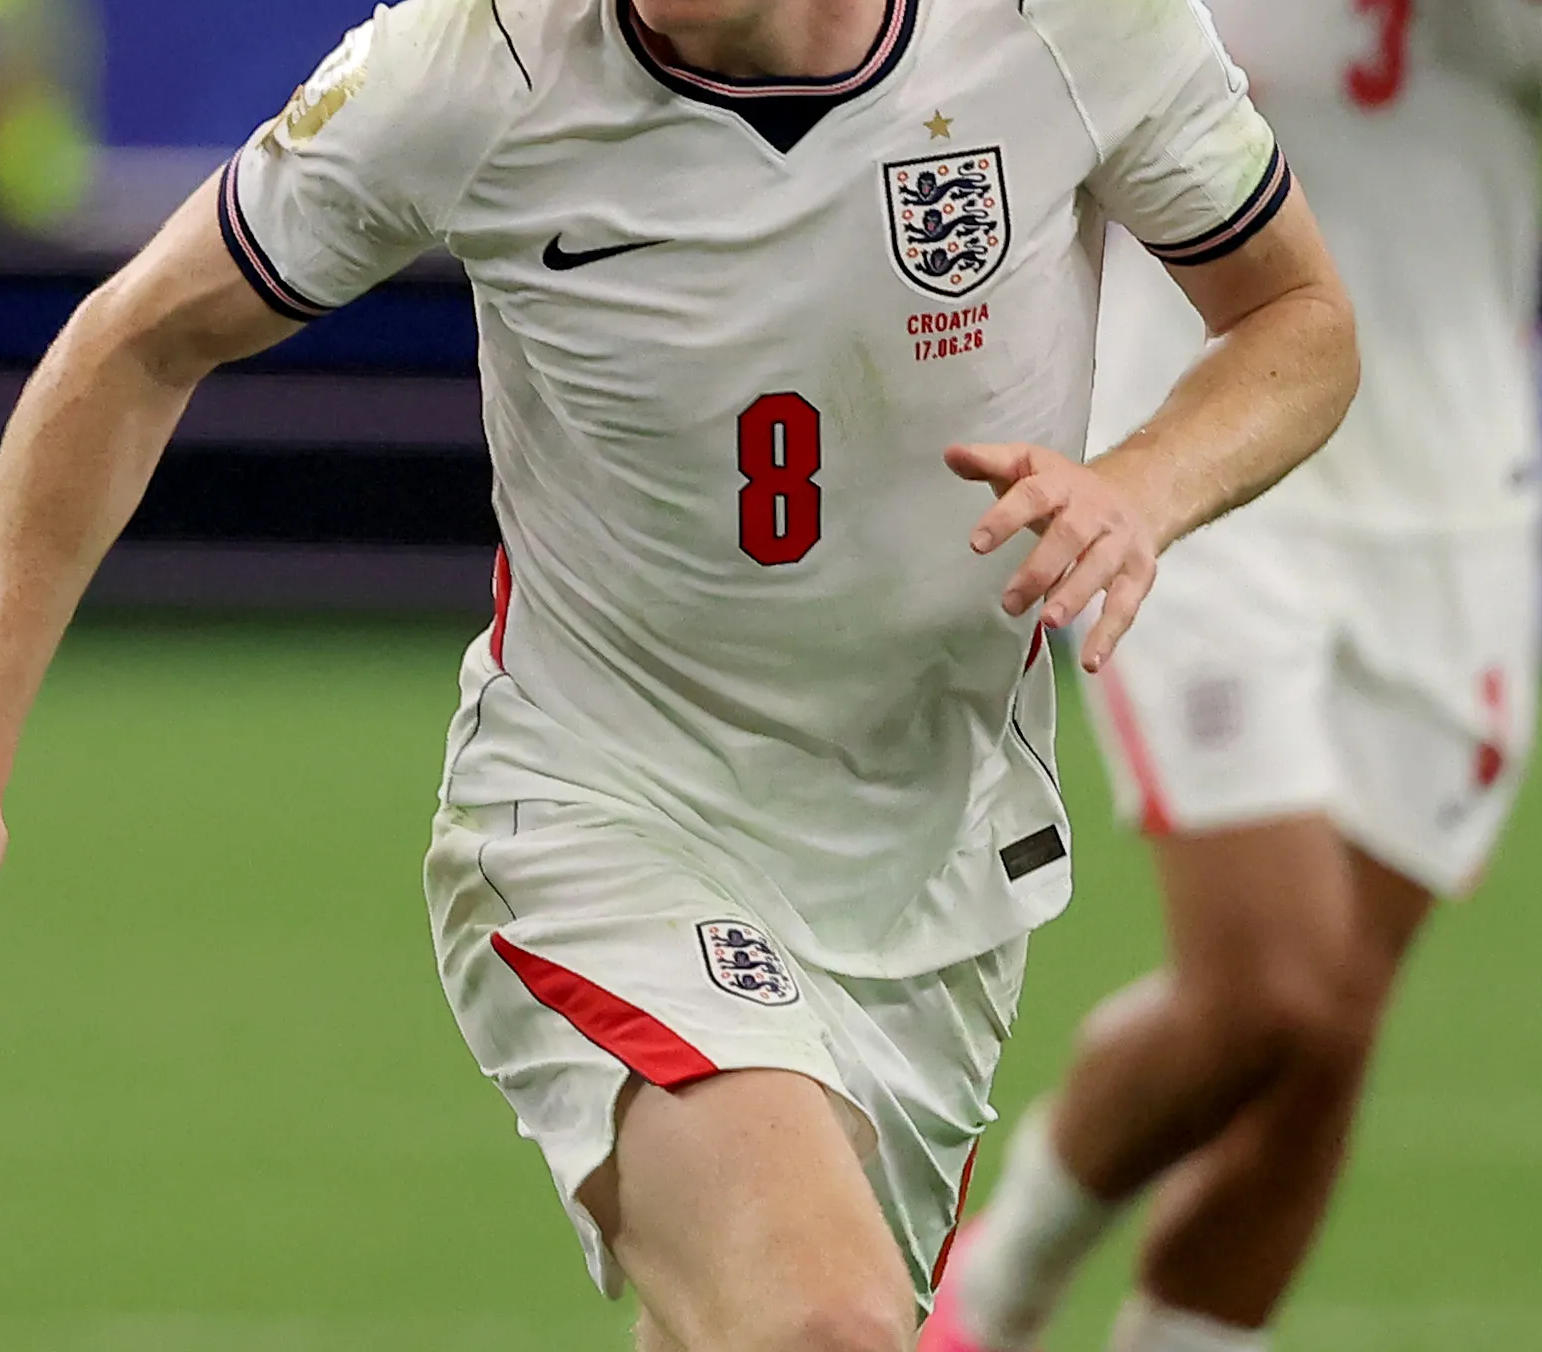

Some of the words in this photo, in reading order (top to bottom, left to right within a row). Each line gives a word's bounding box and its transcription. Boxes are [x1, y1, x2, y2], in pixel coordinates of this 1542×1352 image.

[907, 303, 989, 335] CROATIA
[915, 329, 983, 361] 17.06.26
[737, 391, 821, 565] 8
